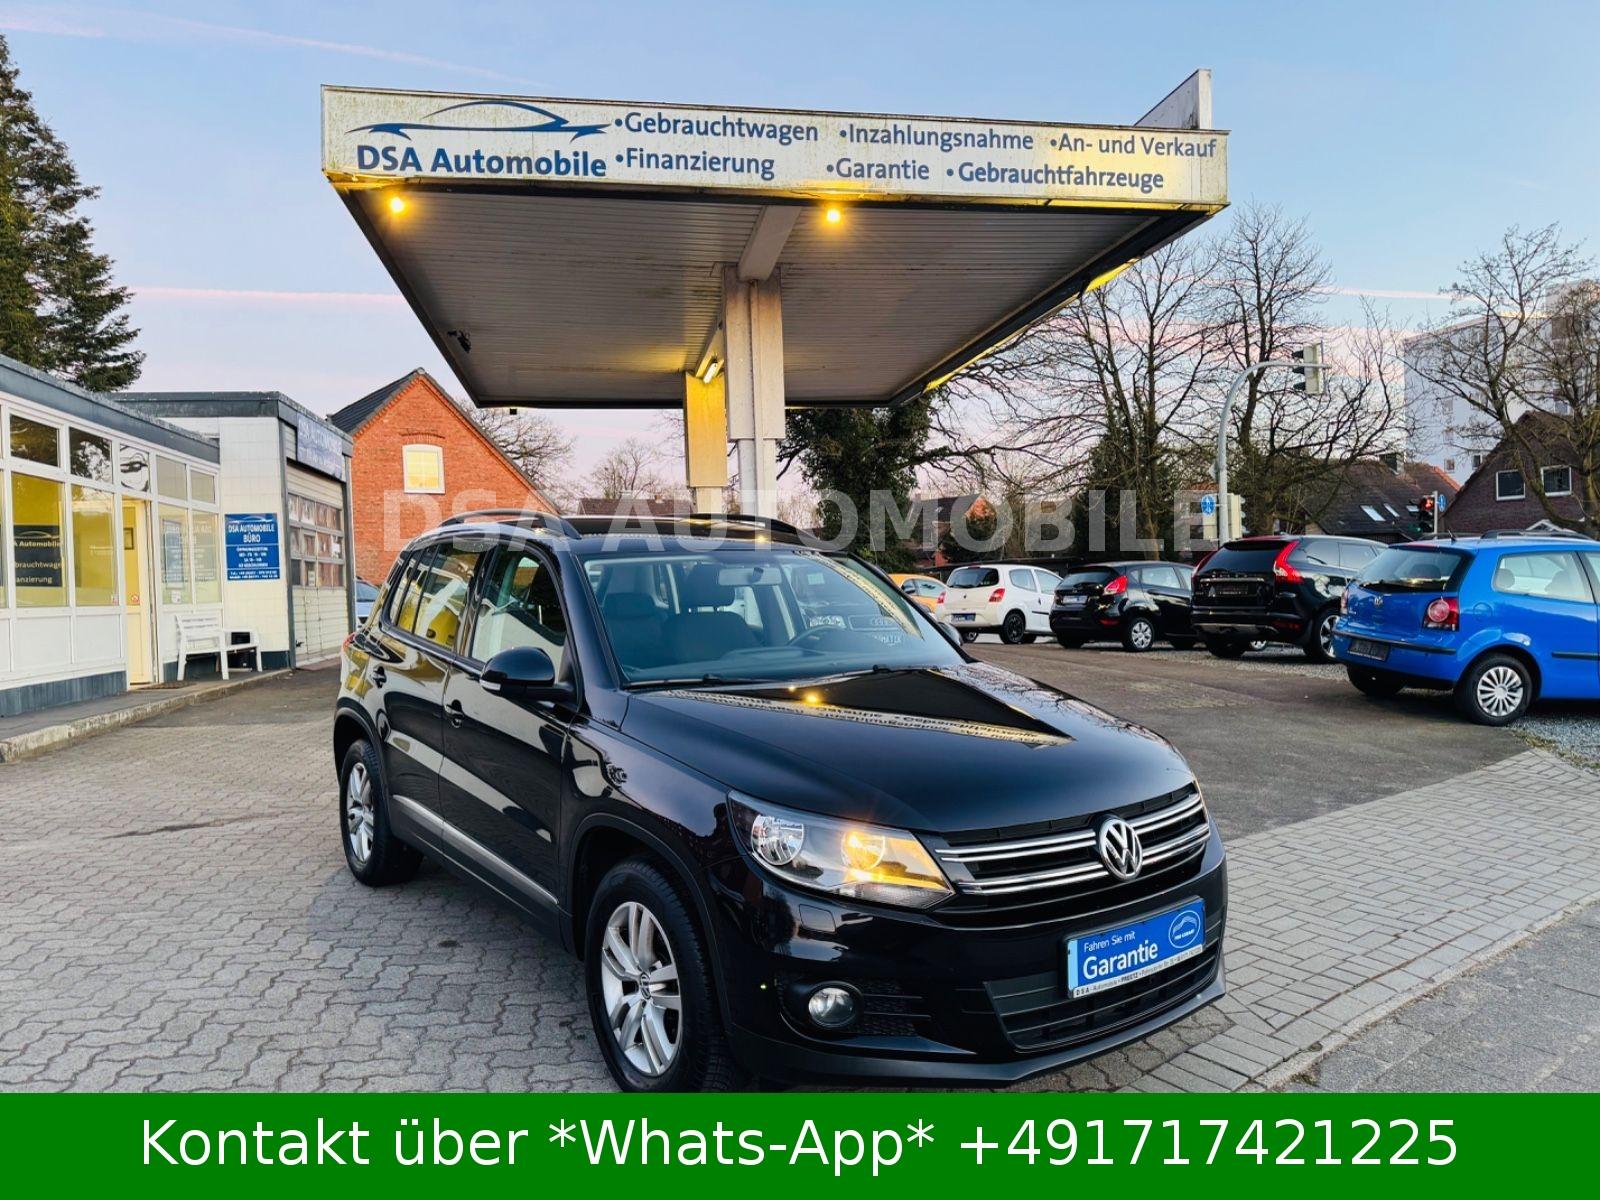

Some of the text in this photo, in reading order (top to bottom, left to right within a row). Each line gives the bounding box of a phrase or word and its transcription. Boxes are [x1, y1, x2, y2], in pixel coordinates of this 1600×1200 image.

[624, 112, 818, 145] Gebrauchtwagen
[849, 124, 1034, 153] Inzahlungsnahme
[1058, 133, 1217, 158] An- und Verkauf
[357, 145, 606, 177] DSA Automobile
[626, 148, 775, 180] Finanzierung
[835, 158, 930, 180] Garantie
[958, 162, 1164, 194] Gebrauchtfahrzeuge
[228, 523, 275, 533] DSA AUTOMOBILE
[243, 532, 261, 543] BÜRO
[1084, 931, 1136, 952] Fahren Sie mit
[1083, 939, 1159, 980] Garantie
